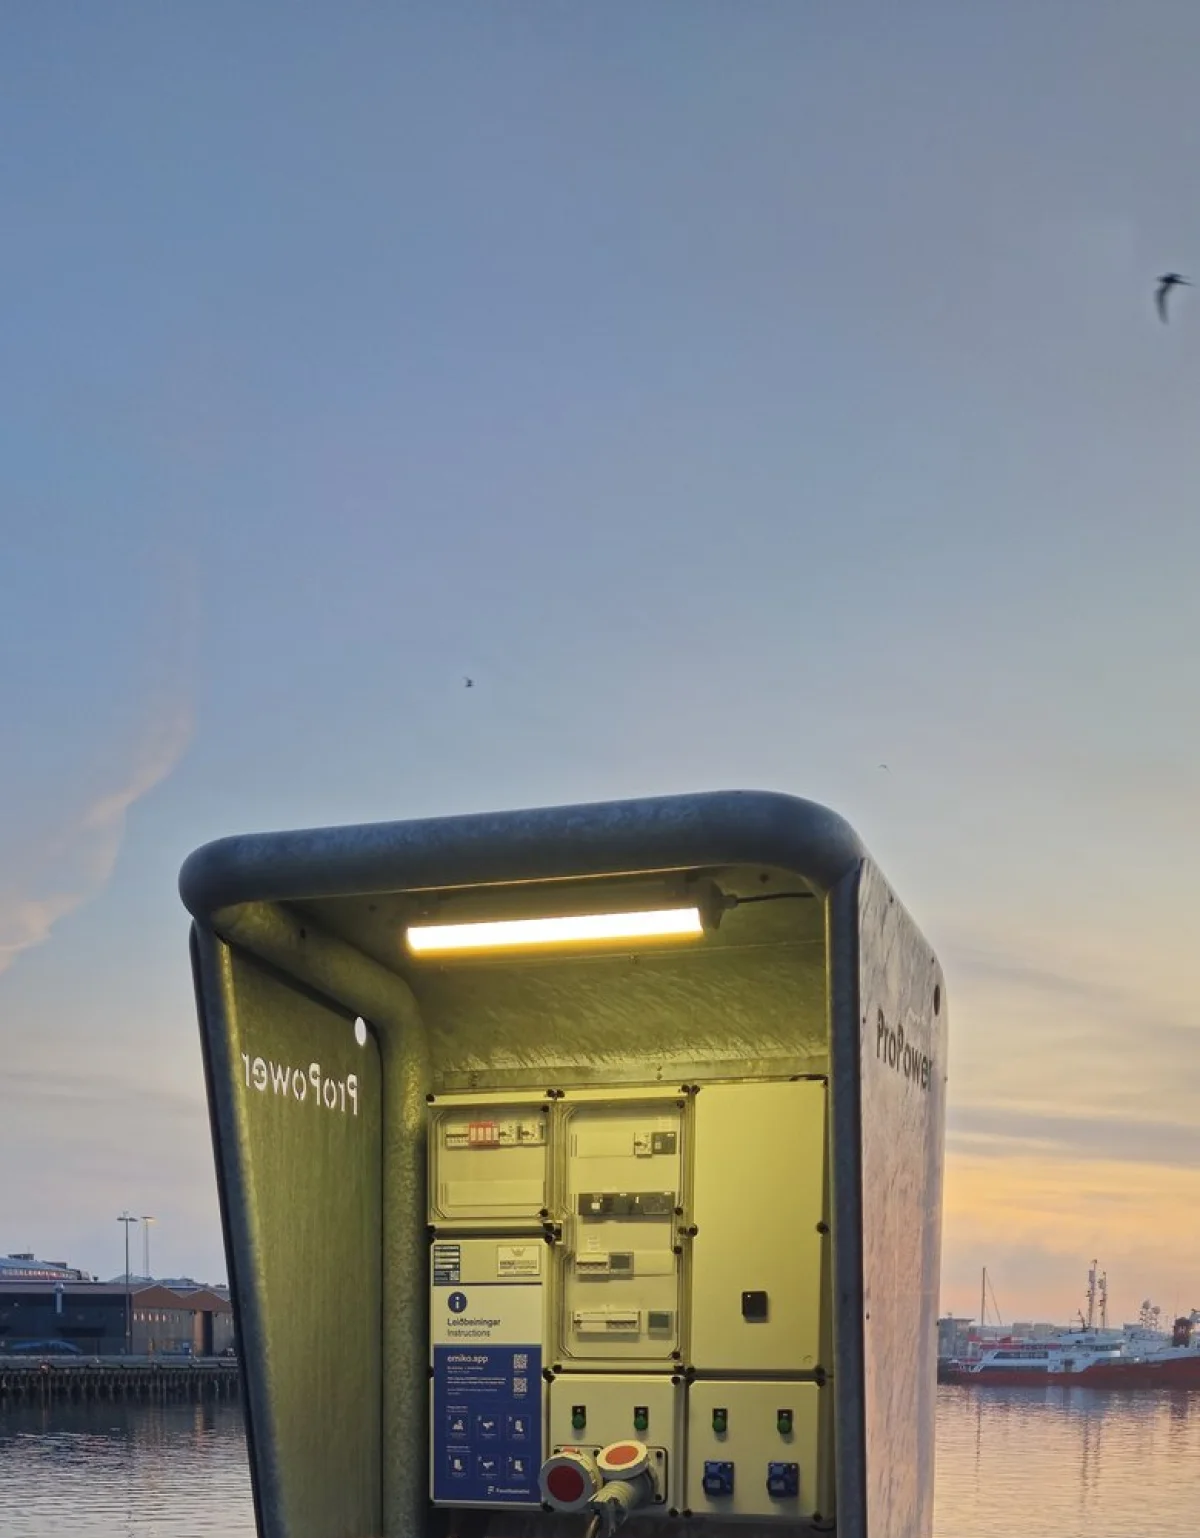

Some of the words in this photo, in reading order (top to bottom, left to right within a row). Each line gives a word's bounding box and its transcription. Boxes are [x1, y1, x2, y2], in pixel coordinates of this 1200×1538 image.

[876, 1005, 933, 1092] ProPower
[447, 1329, 490, 1337] Instructions
[447, 1354, 489, 1364] emiko.app
